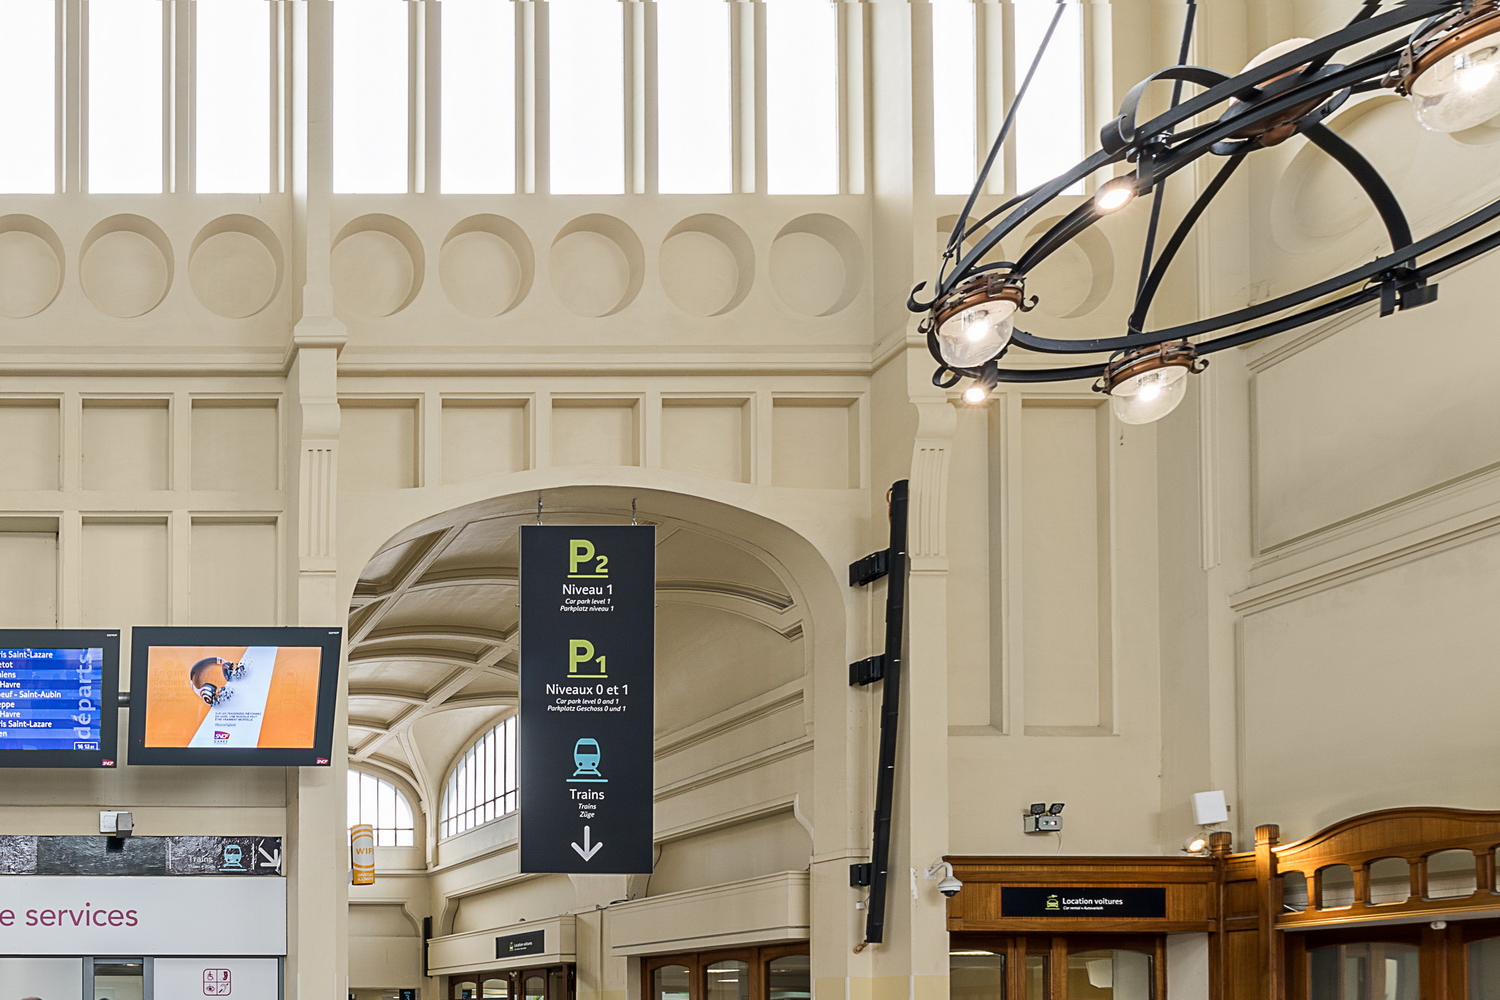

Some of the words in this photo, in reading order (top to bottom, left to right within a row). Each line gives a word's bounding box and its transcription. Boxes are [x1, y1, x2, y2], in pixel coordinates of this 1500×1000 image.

[562, 584, 603, 595] Niveau
[607, 584, 612, 595] 1
[8, 651, 53, 659] Saint-Lazare
[19, 690, 61, 698] Saint-Aubin
[71, 649, 96, 739] départs
[546, 684, 593, 695] Niveaux
[596, 684, 604, 695] 0
[606, 685, 619, 695] et
[622, 685, 628, 695] 1
[7, 720, 53, 728] Saint-Lazare
[569, 789, 605, 799] Trains
[188, 855, 213, 863] Trains
[25, 901, 139, 927] services
